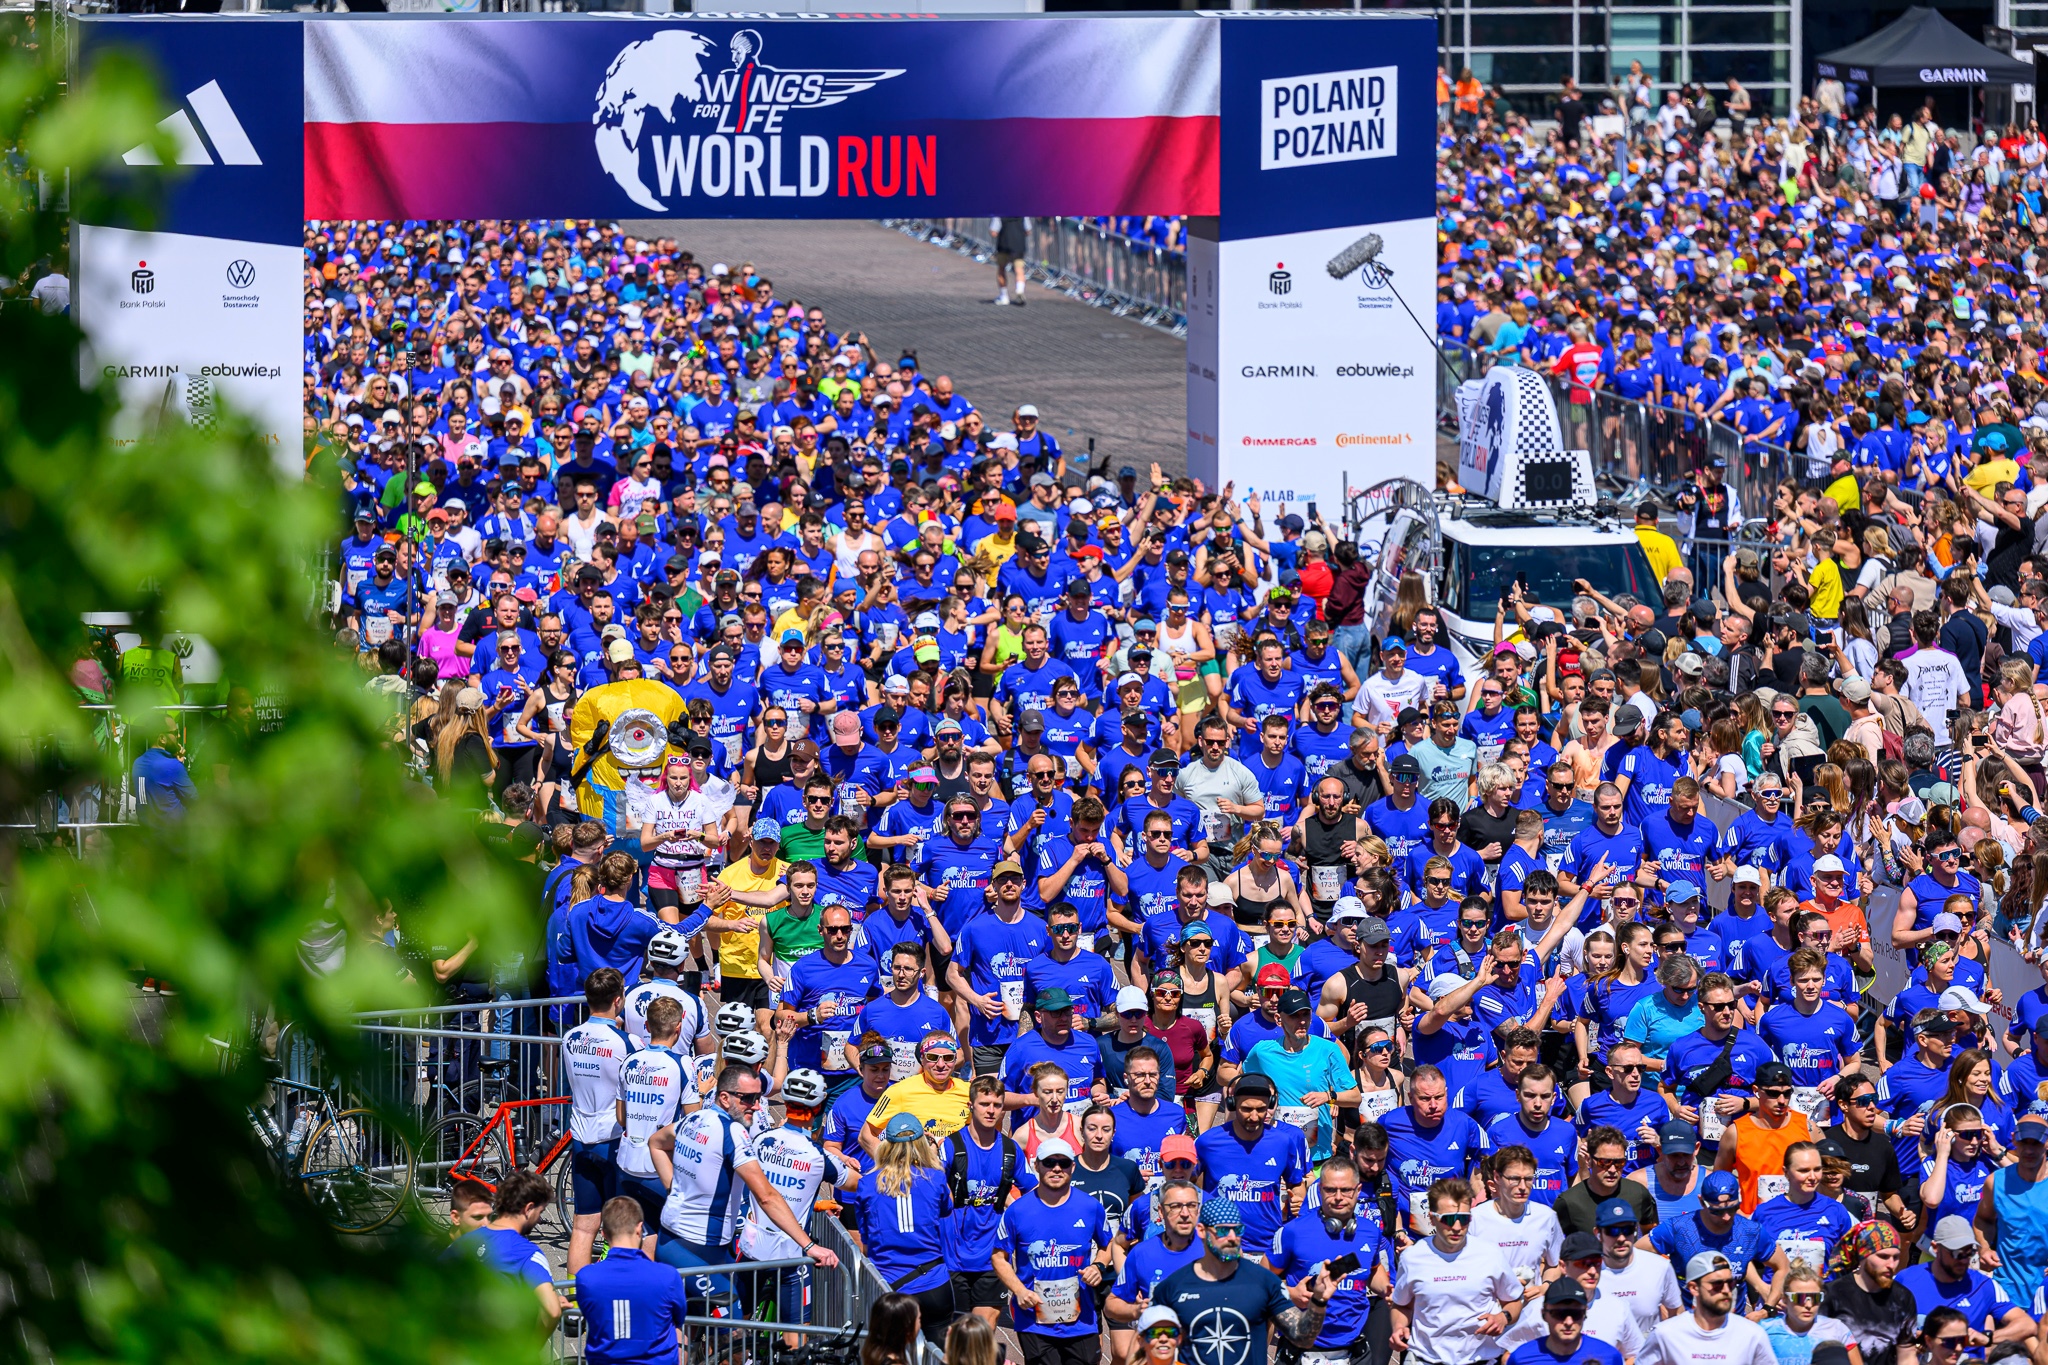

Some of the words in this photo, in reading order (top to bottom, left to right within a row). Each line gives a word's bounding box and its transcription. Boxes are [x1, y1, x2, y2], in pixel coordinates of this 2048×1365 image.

[1920, 68, 1987, 83] GARMIN
[701, 63, 824, 104] WINGS
[1274, 76, 1385, 118] POLAND
[693, 104, 719, 118] FOR
[716, 104, 783, 134] LIFE
[1274, 108, 1385, 160] POZNAŃ
[651, 135, 830, 197] WORLD
[837, 135, 937, 196] RUN
[120, 300, 141, 308] Bank
[144, 300, 165, 308] Polski
[222, 295, 260, 303] Samochody
[103, 365, 179, 378] GARMIN
[200, 364, 281, 378] eobuwie.pl
[1241, 366, 1318, 378] GARMIN
[1336, 363, 1414, 379] eobuwie.pl
[1335, 433, 1402, 448] Continental
[1534, 474, 1562, 491] 0.0
[1262, 489, 1294, 501] ALAB
[1578, 486, 1591, 494] km
[1070, 649, 1091, 659] WORLD
[130, 667, 165, 677] MOTO
[713, 725, 736, 733] WORLD
[1437, 771, 1456, 781] WORLD
[1456, 771, 1468, 779] RUN
[1646, 794, 1670, 805] WORLD
[656, 810, 671, 821] DLA
[677, 808, 695, 819] TYCH
[1664, 860, 1691, 871] WORLD
[951, 879, 976, 888] WORLD
[1071, 887, 1094, 898] WORLD
[999, 965, 1023, 977] WORLD
[572, 1044, 596, 1055] WORLD
[596, 1047, 612, 1058] RUN
[1455, 1051, 1474, 1061] WORLD
[573, 1061, 599, 1071] PHILIPS
[1789, 1057, 1818, 1068] WORLD
[1818, 1059, 1833, 1068] RUN
[627, 1074, 653, 1086] WORLD
[653, 1076, 668, 1086] RUN
[625, 1112, 657, 1121] eadphones
[682, 1128, 696, 1143] WORLD
[696, 1132, 709, 1145] RUN
[675, 1140, 702, 1163] PHILIPS
[763, 1151, 792, 1168] WORLD
[792, 1155, 811, 1172] RUN
[1416, 1166, 1441, 1176] WINGS
[761, 1169, 805, 1189] HILIPS
[1237, 1180, 1255, 1189] WINGS
[1228, 1191, 1262, 1202] WORLD
[1261, 1192, 1274, 1202] RUN
[1962, 1192, 1981, 1203] WORLD
[1045, 1243, 1066, 1252] WINGS
[1036, 1255, 1068, 1268] WORLD
[1068, 1255, 1084, 1267] RUN
[1047, 1298, 1071, 1307] 10044
